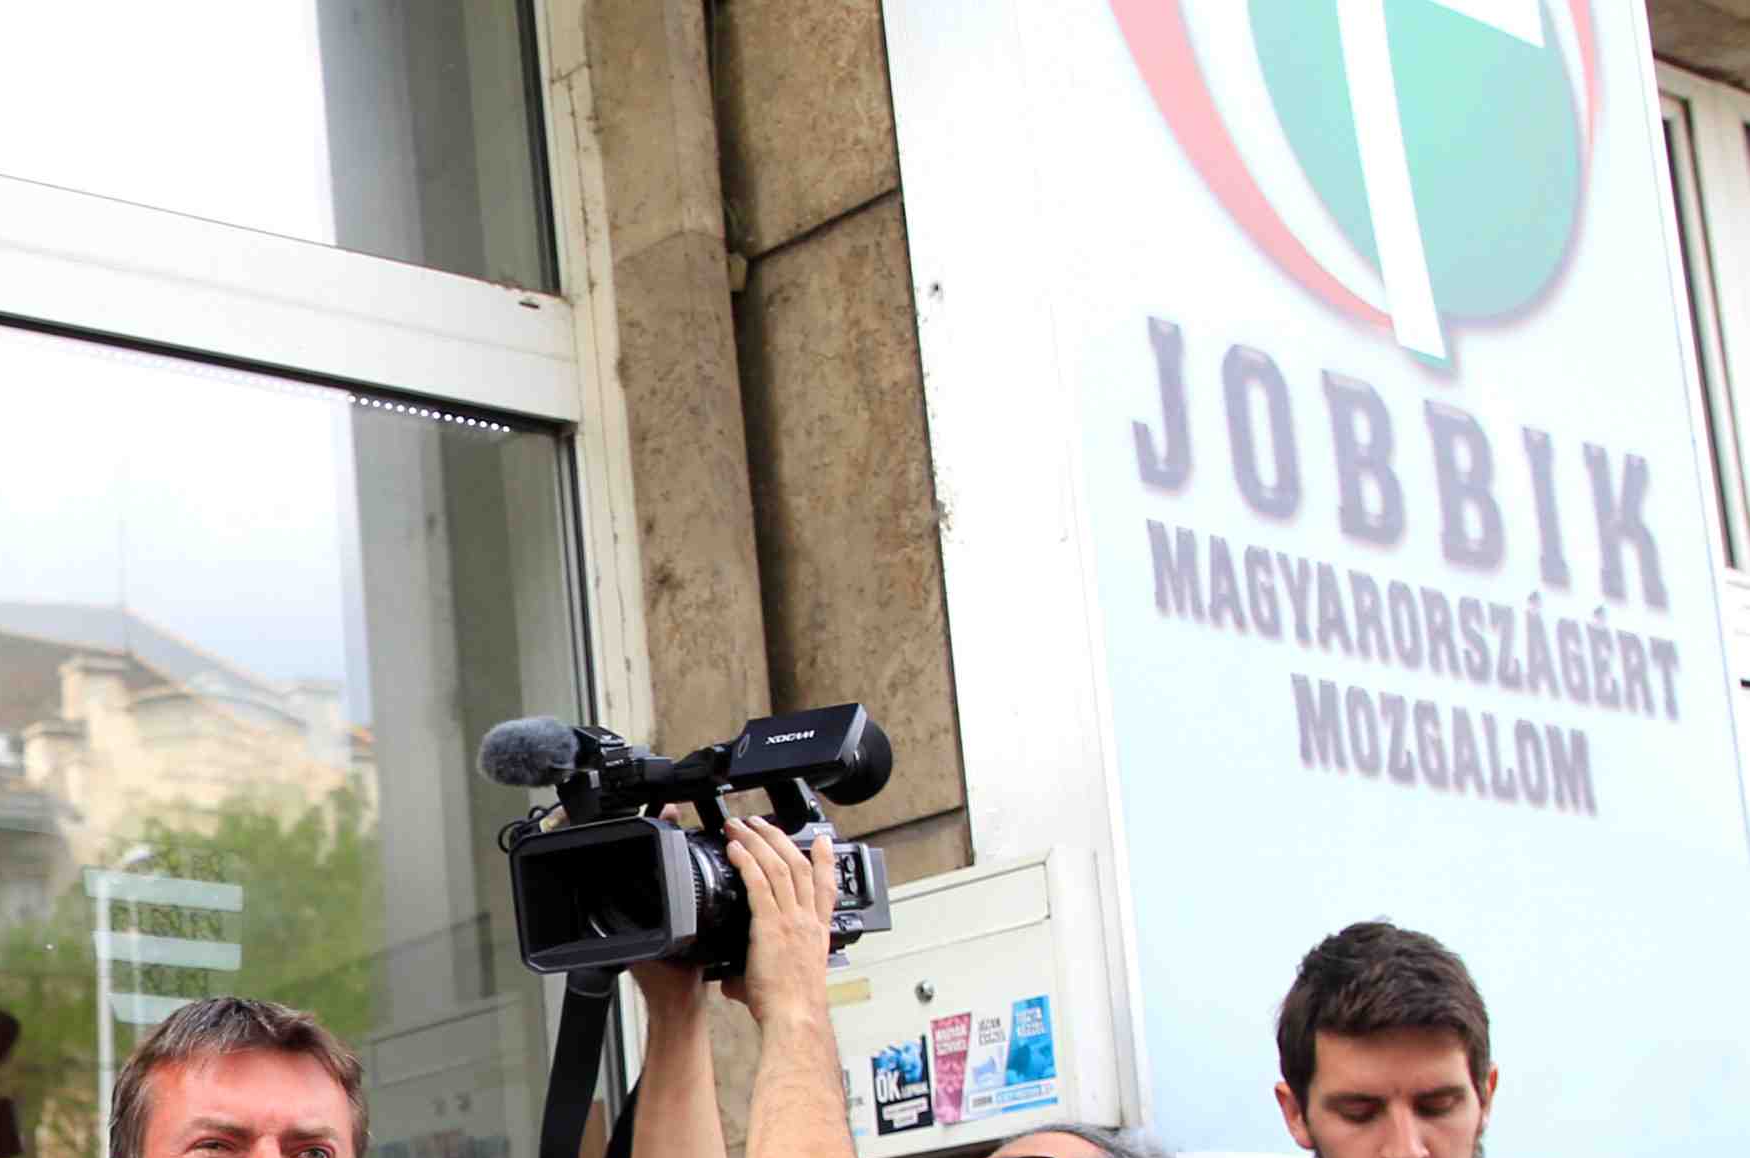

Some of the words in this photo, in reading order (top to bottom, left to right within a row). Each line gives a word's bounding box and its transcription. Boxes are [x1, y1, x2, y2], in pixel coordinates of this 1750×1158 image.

[1132, 314, 1670, 614] JOBBIK
[1146, 516, 1681, 722] MAGYARORSZÁGÉRT
[1290, 671, 1598, 817] MOZGALOM
